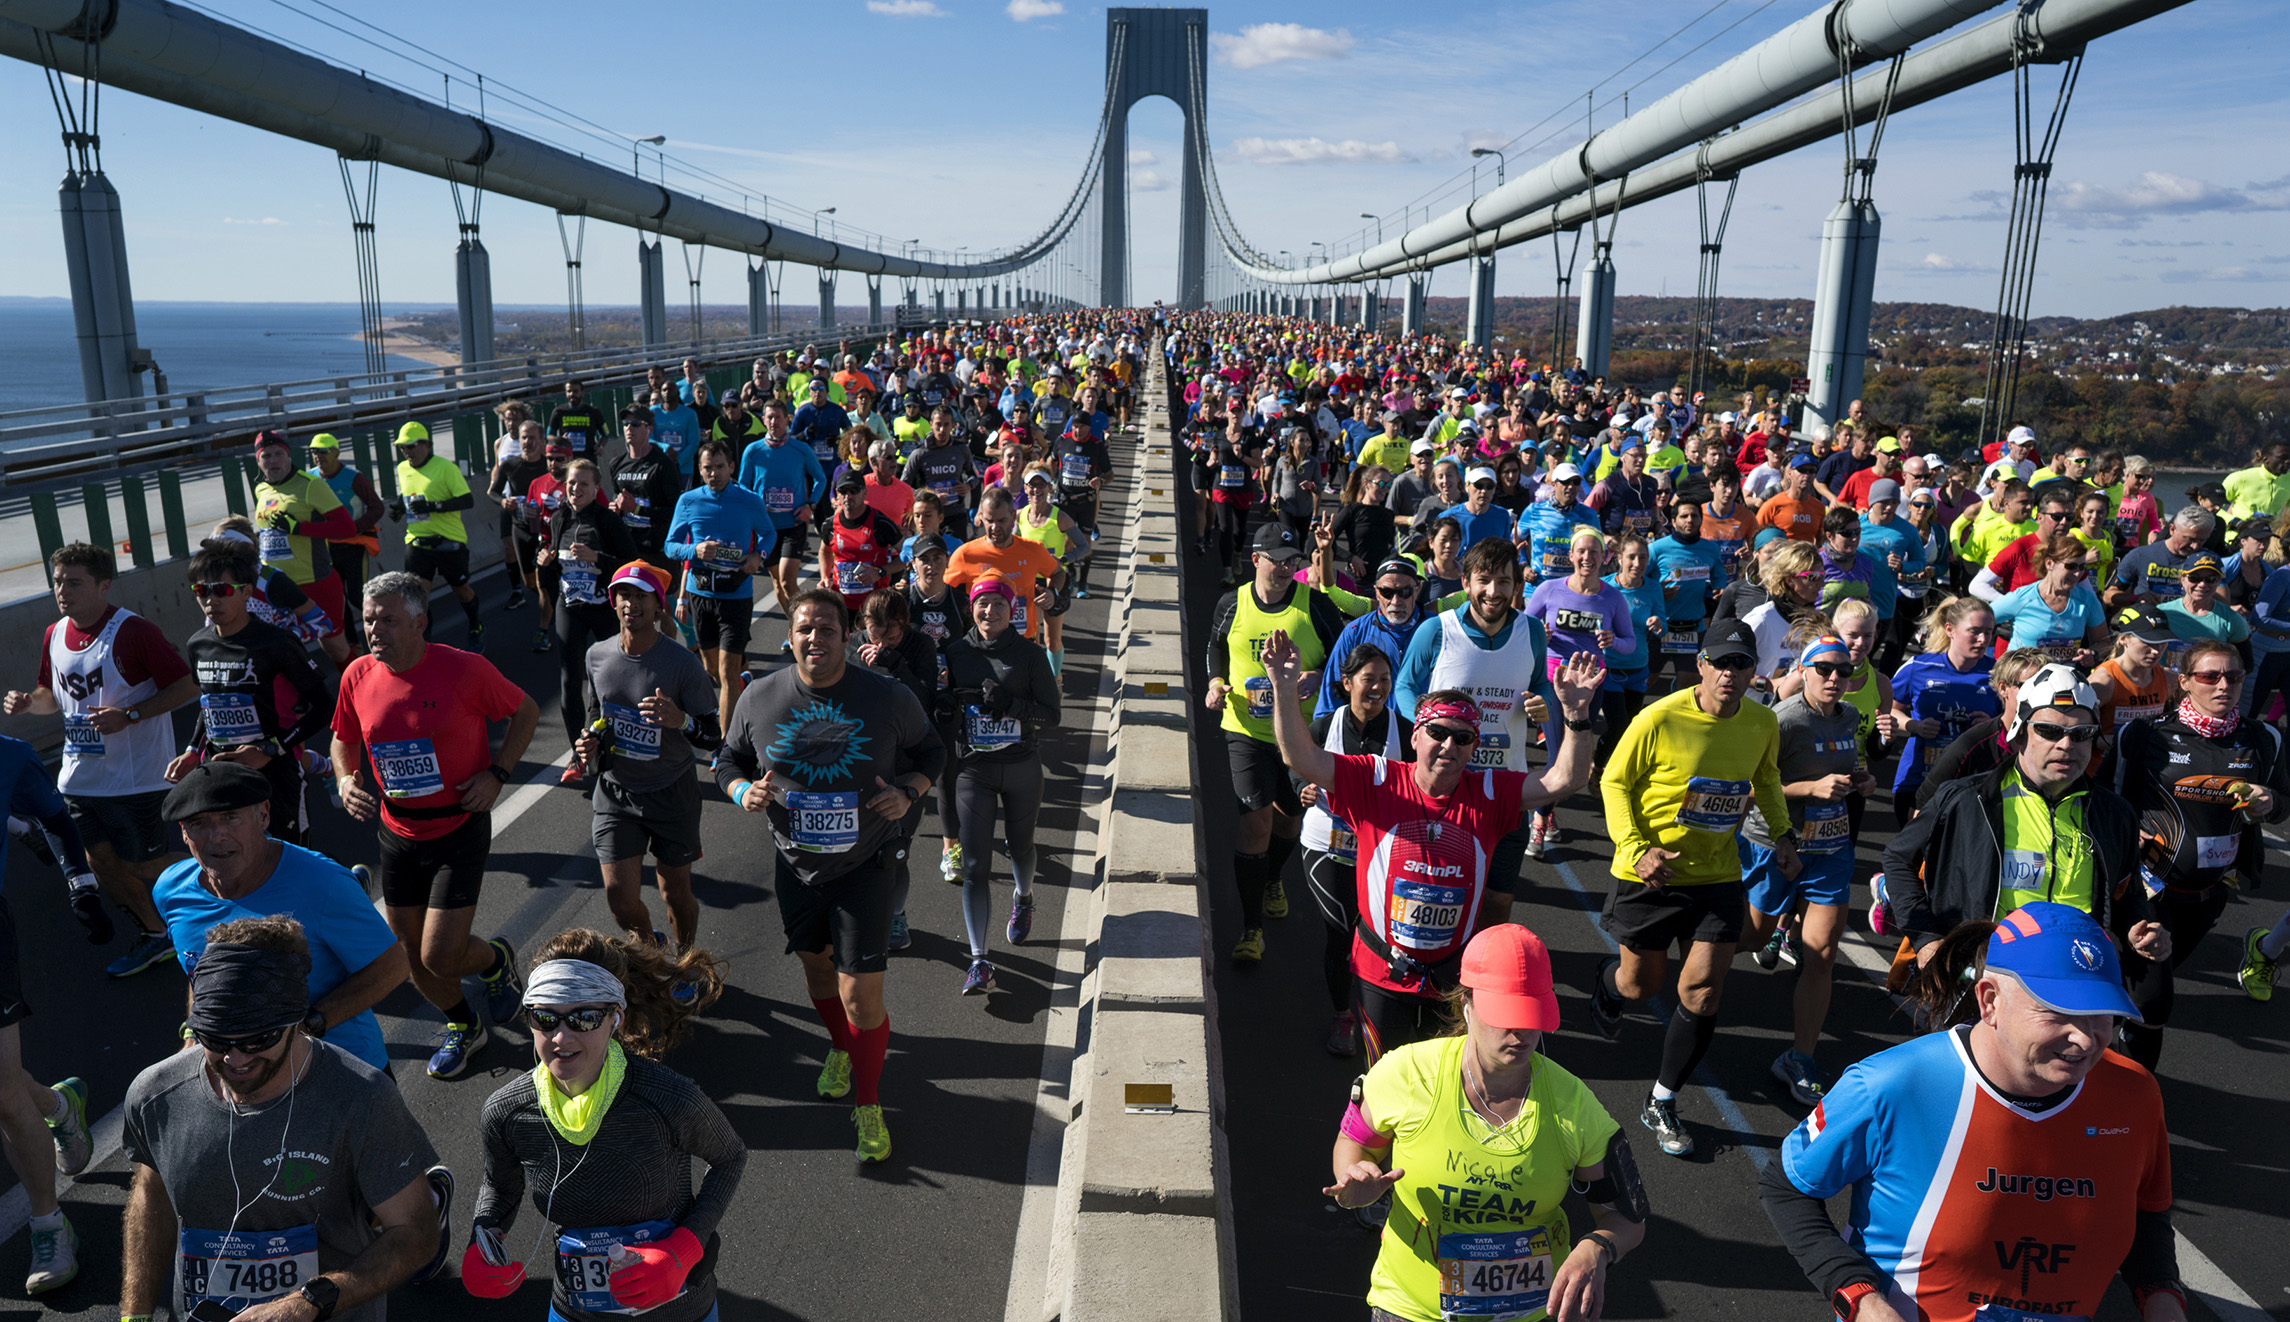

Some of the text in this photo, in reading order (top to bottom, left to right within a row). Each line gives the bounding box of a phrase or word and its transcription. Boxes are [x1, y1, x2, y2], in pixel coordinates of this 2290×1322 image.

[617, 472, 648, 481] JORDAN
[931, 464, 956, 475] NICO
[1793, 514, 1811, 523] ROB
[1545, 536, 1570, 544] ALBER
[1998, 534, 2019, 542] Achill
[2148, 562, 2183, 578] Cross
[55, 665, 104, 701] USA
[1476, 686, 1482, 696] &
[1484, 687, 1516, 698] STEADY
[2129, 693, 2160, 706] SWIZ
[1478, 700, 1512, 711] FINISHES
[212, 708, 254, 726] 39886
[617, 721, 657, 744] 39273
[980, 719, 1016, 735] 39747
[1469, 749, 1504, 765] 9373
[388, 756, 434, 777] 38659
[2174, 785, 2228, 797] SPORTSHO
[1701, 796, 1742, 814] 46194
[793, 811, 800, 820] 3
[805, 811, 854, 831] 38275
[1398, 898, 1404, 910] 3
[1397, 911, 1403, 921] F
[1410, 904, 1458, 927] 48103
[288, 1150, 330, 1166] ISLAND
[1975, 1167, 2096, 1202] Jurgen
[1438, 1183, 1537, 1217] TEAM
[1443, 1204, 1451, 1222] FOR
[204, 1241, 256, 1250] CONSULTANCY
[266, 1247, 289, 1255] TATA
[586, 1246, 609, 1254] SERVIC
[1461, 1243, 1506, 1251] CONSULTANCY
[1530, 1240, 1548, 1249] TFK
[214, 1249, 247, 1257] SERVICES
[1994, 1240, 2077, 1274] VRF
[571, 1258, 580, 1273] 3
[1451, 1261, 1460, 1276] 3
[225, 1260, 298, 1293] 7488
[573, 1275, 582, 1290] C
[1472, 1259, 1546, 1293] 46744
[194, 1277, 205, 1294] C
[1451, 1279, 1460, 1294] D
[1968, 1291, 2077, 1315] EUROFAST
